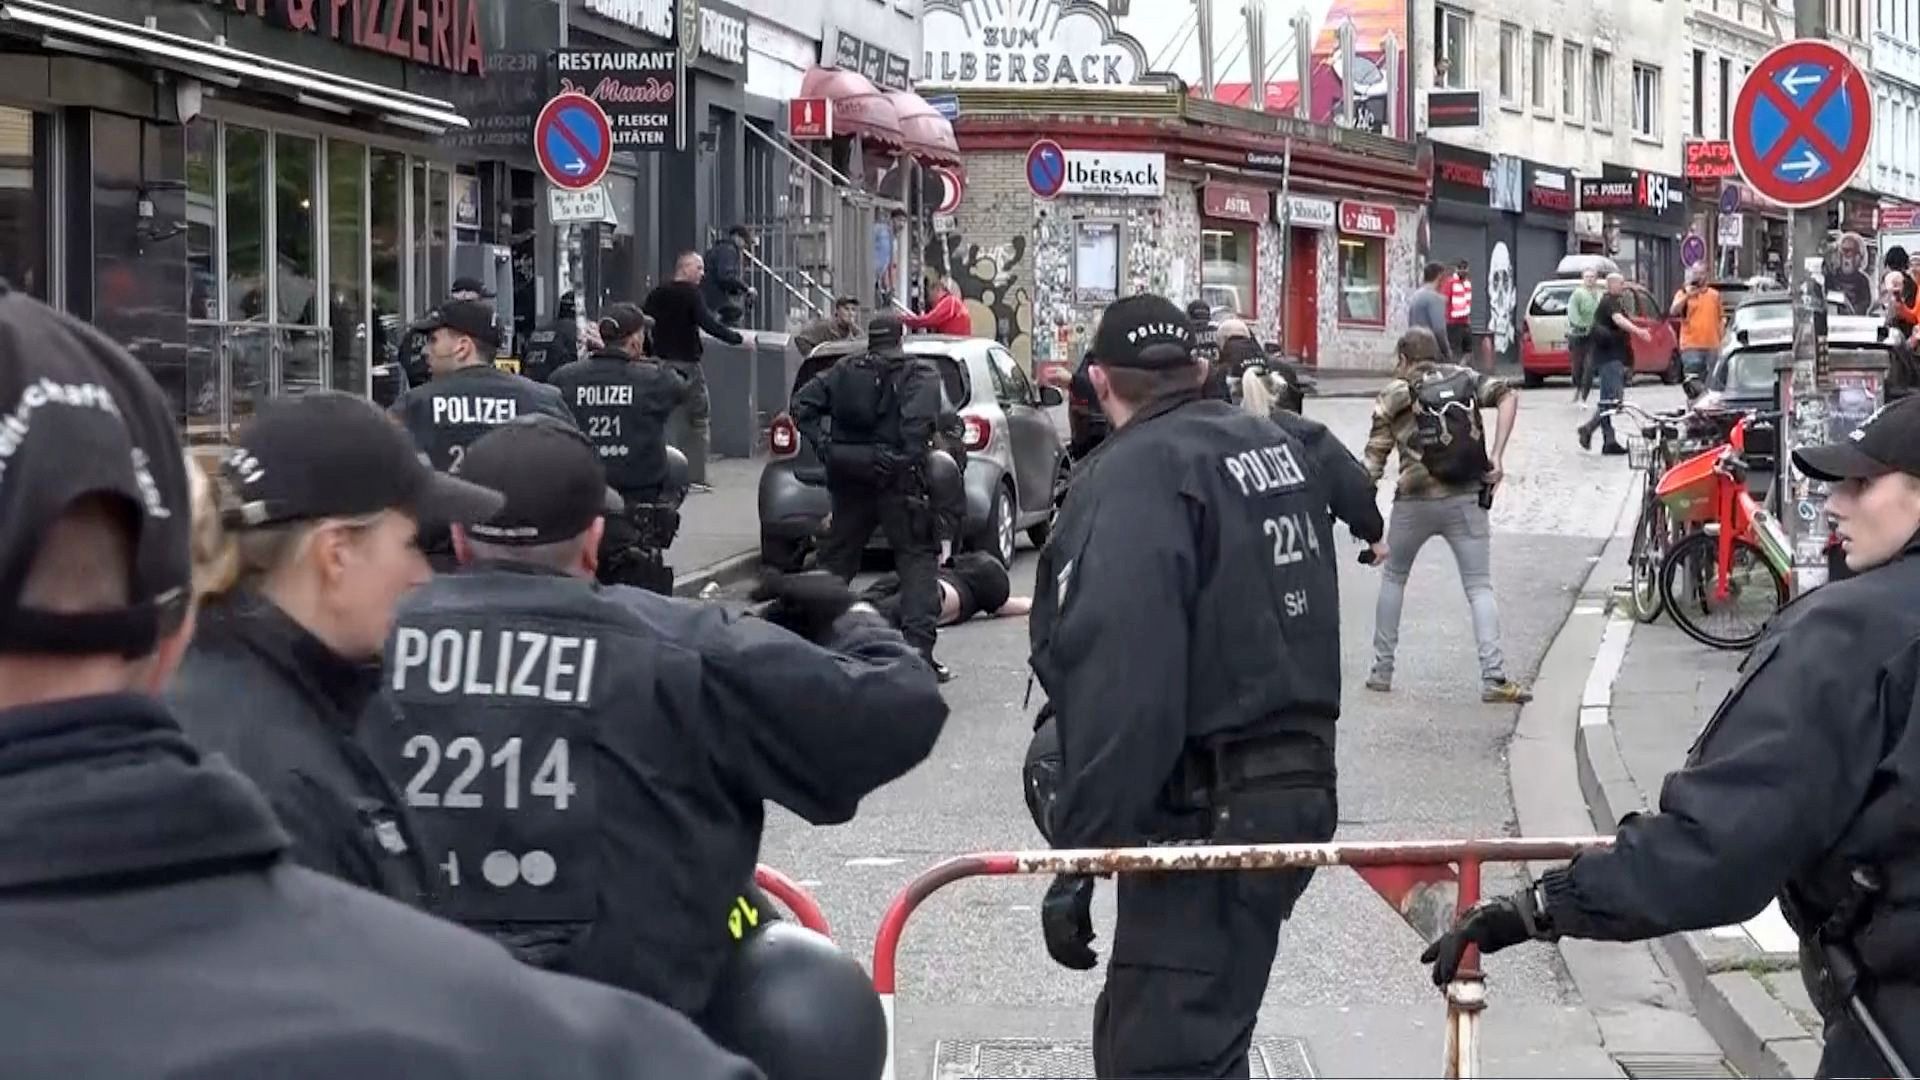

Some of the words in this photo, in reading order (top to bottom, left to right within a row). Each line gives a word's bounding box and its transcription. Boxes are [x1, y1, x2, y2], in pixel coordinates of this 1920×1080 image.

[983, 26, 1039, 49] ZUM
[558, 52, 675, 71] RESTAURANT
[924, 50, 1123, 85] ILBERSACK
[617, 114, 668, 127] FLEISCH
[612, 129, 664, 145] LITÄTEN
[1600, 182, 1633, 197] PAULI
[1127, 322, 1190, 345] POLIZEI
[577, 385, 634, 407] POLIZEI
[432, 396, 517, 425] POLIZEI
[1224, 442, 1306, 497] POLIZEI
[1284, 588, 1309, 618] SH
[392, 626, 598, 704] POLIZEI
[402, 734, 577, 811] 2214
